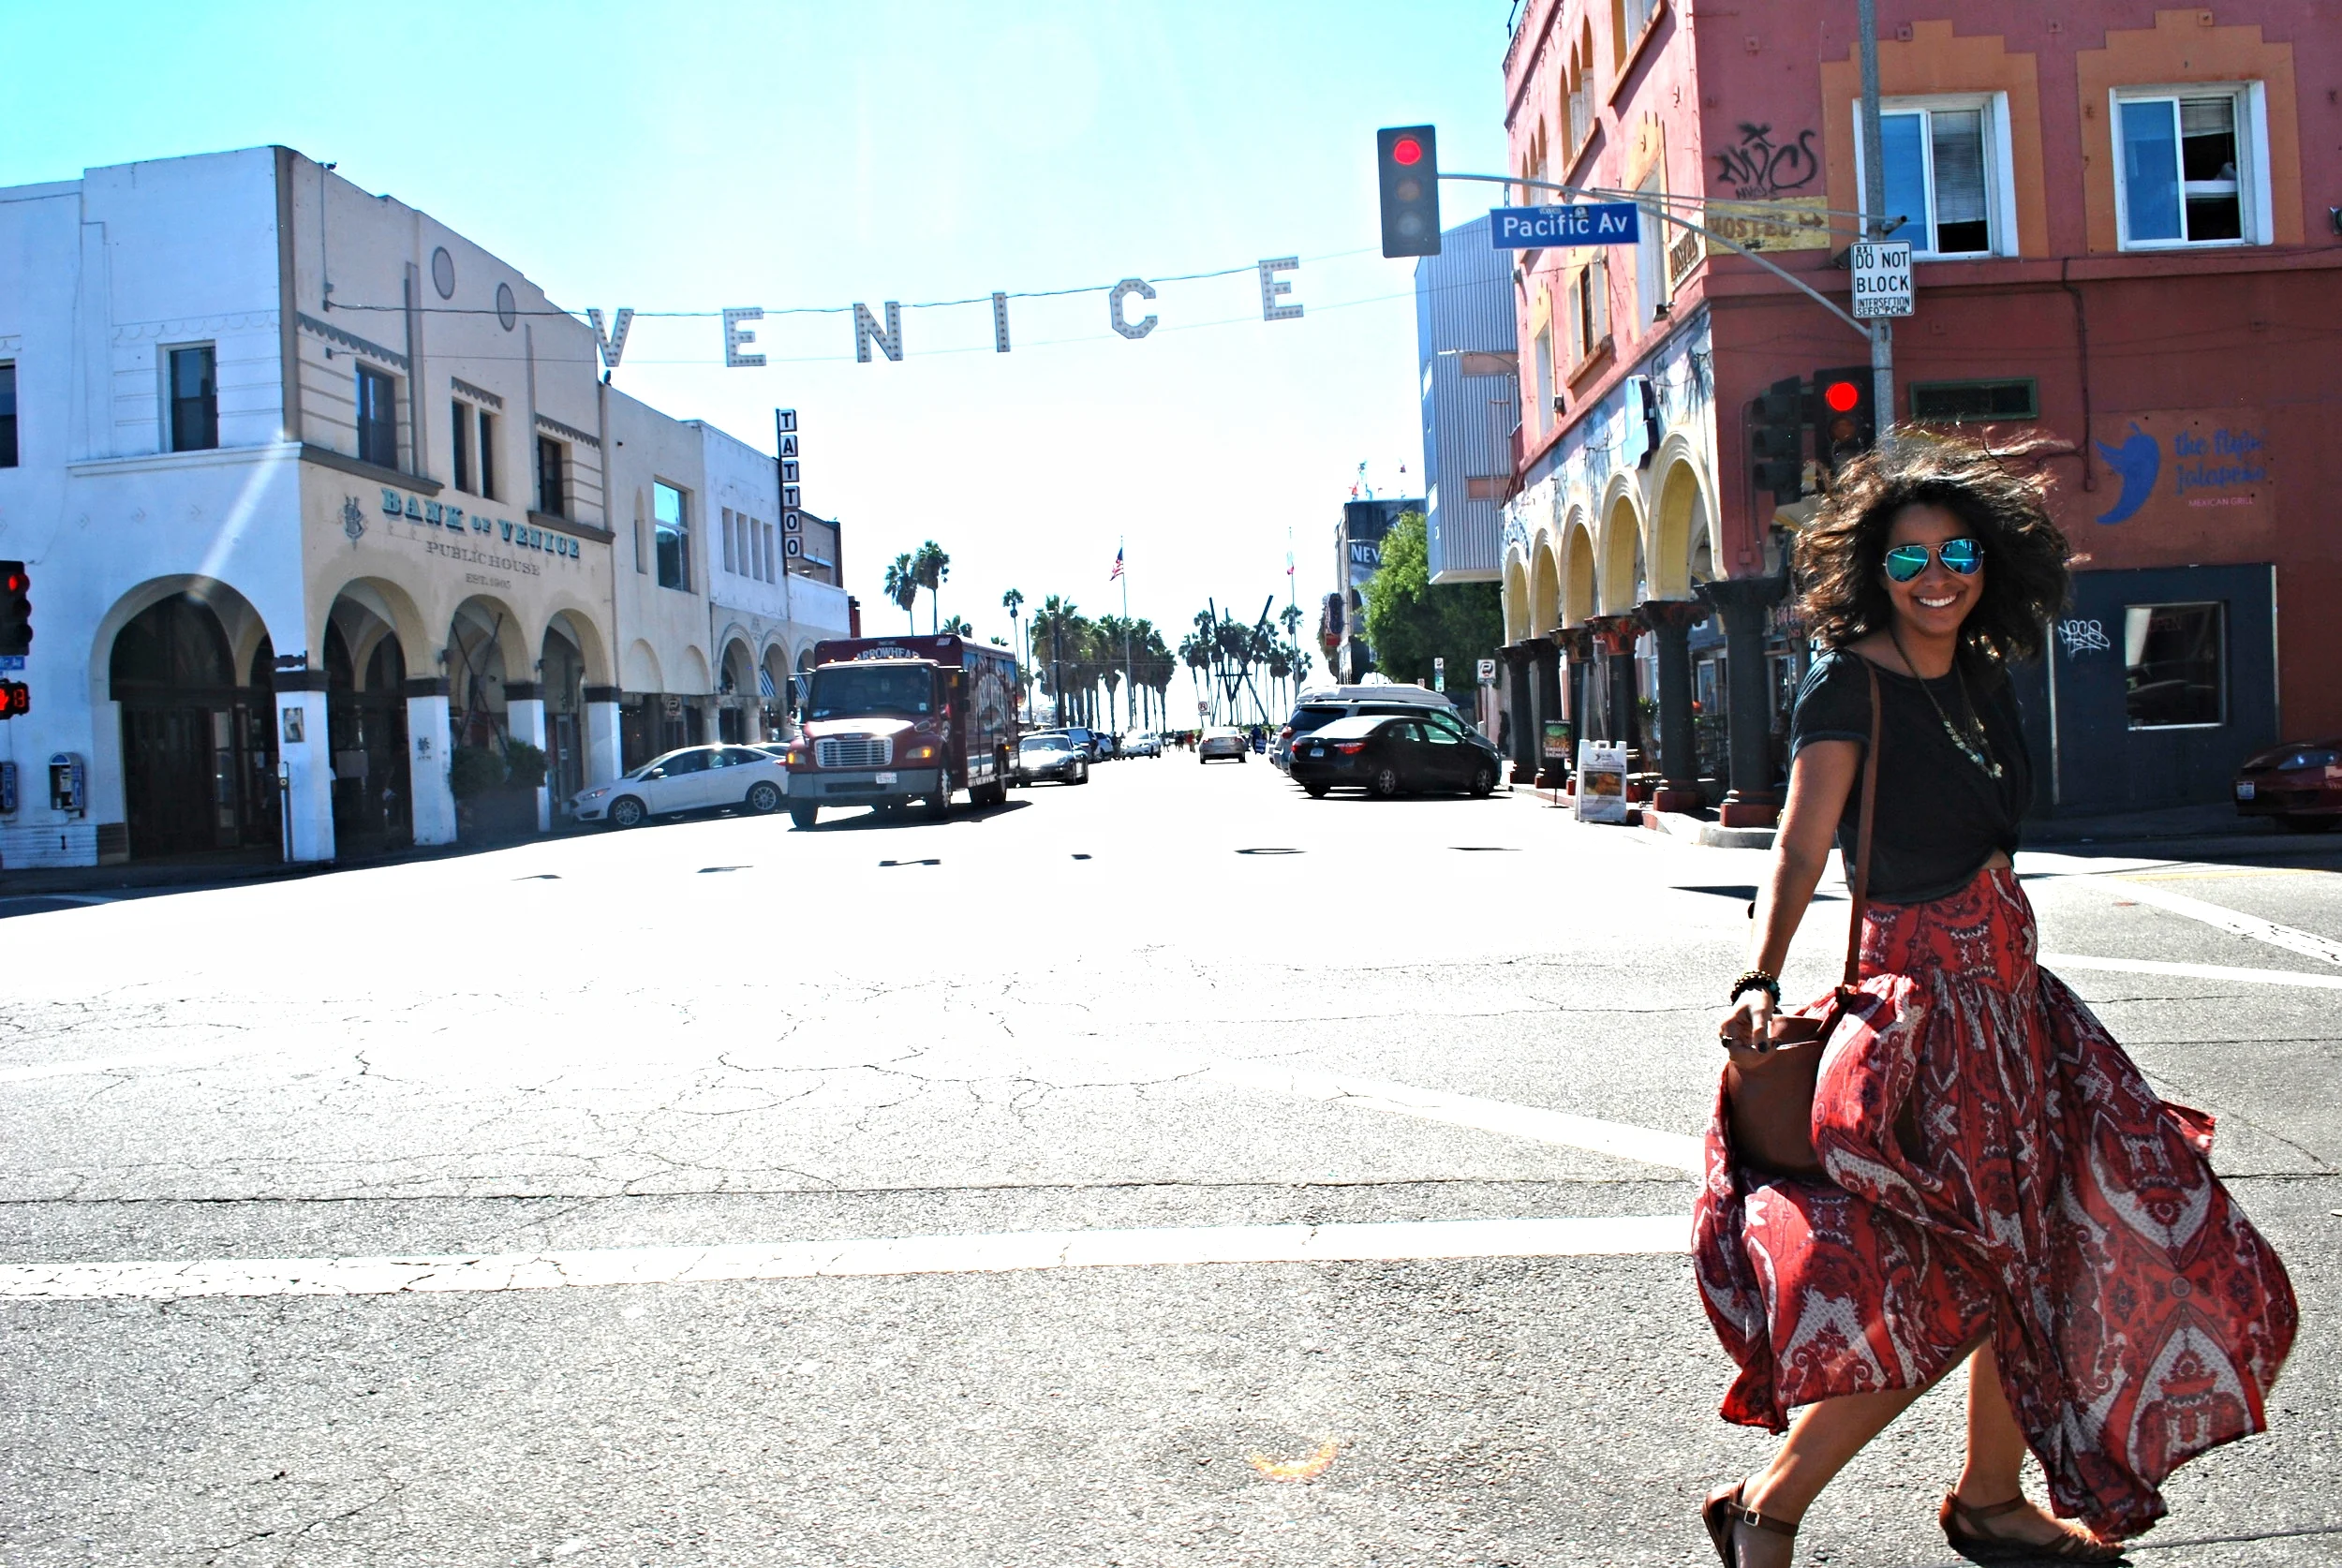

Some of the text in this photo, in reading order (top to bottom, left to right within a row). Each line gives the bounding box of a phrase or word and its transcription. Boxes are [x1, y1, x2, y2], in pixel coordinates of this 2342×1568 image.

[1503, 214, 1590, 238] Pacific
[1597, 212, 1628, 234] Av
[1856, 251, 1908, 269] DO NOT
[1856, 274, 1909, 293] BLOCK
[586, 256, 1304, 368] VENICE
[2173, 429, 2208, 457] the
[779, 412, 799, 555] TATTOO
[2187, 496, 2253, 507] MEXICAN GRILL
[380, 487, 580, 559] BANK OF VENICE
[425, 540, 541, 577] PUBLIC HOUSE
[855, 646, 921, 660] ARROWHEAD
